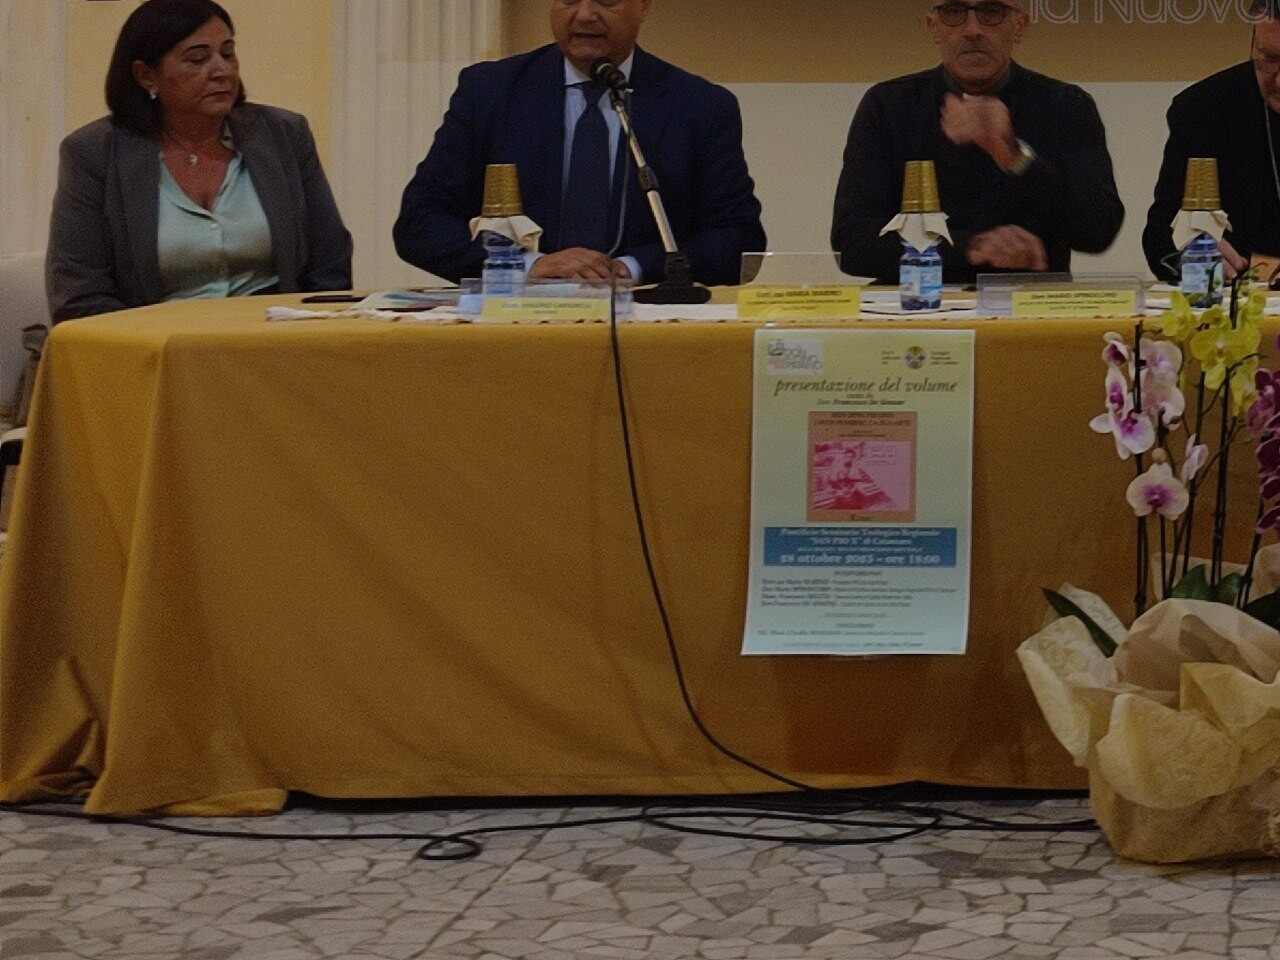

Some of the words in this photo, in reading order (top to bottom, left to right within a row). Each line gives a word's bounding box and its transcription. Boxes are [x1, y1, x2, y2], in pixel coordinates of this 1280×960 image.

[775, 376, 875, 397] presentazione
[878, 376, 901, 393] del
[905, 377, 958, 393] volume
[797, 551, 843, 564] ottobre
[845, 553, 874, 564] 2025
